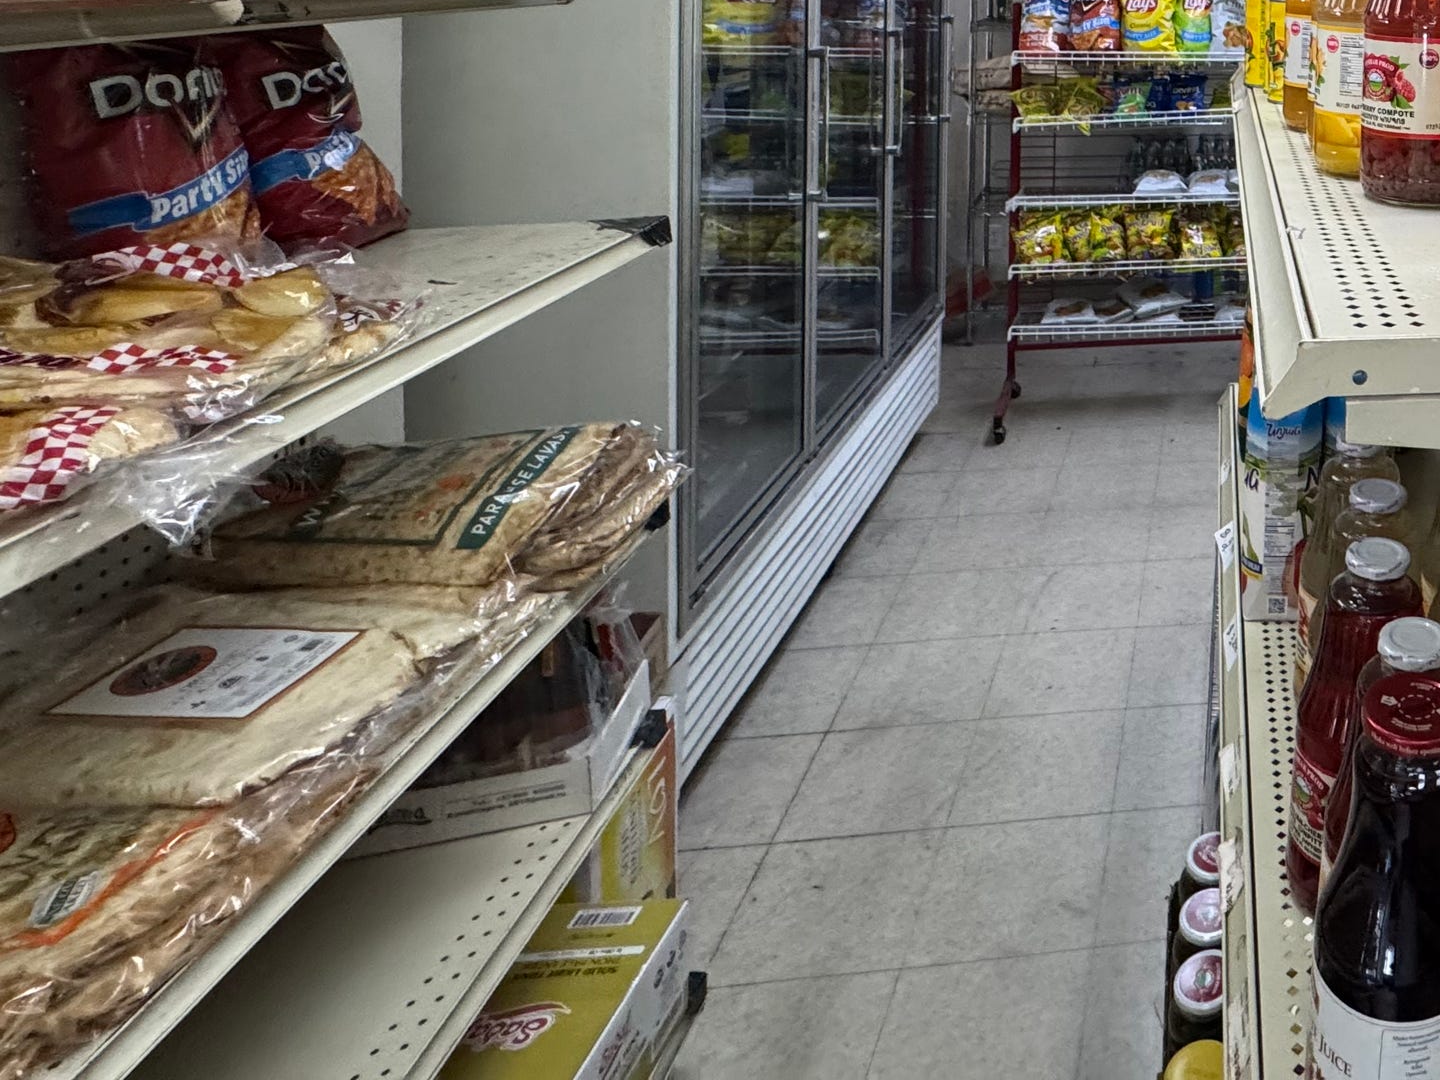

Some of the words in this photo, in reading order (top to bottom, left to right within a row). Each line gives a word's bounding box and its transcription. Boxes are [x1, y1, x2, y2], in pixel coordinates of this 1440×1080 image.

[1377, 107, 1415, 118] COMPOTE
[151, 170, 227, 224] Party
[468, 1016, 548, 1046] Sada
[1317, 1033, 1353, 1075] JUICE
